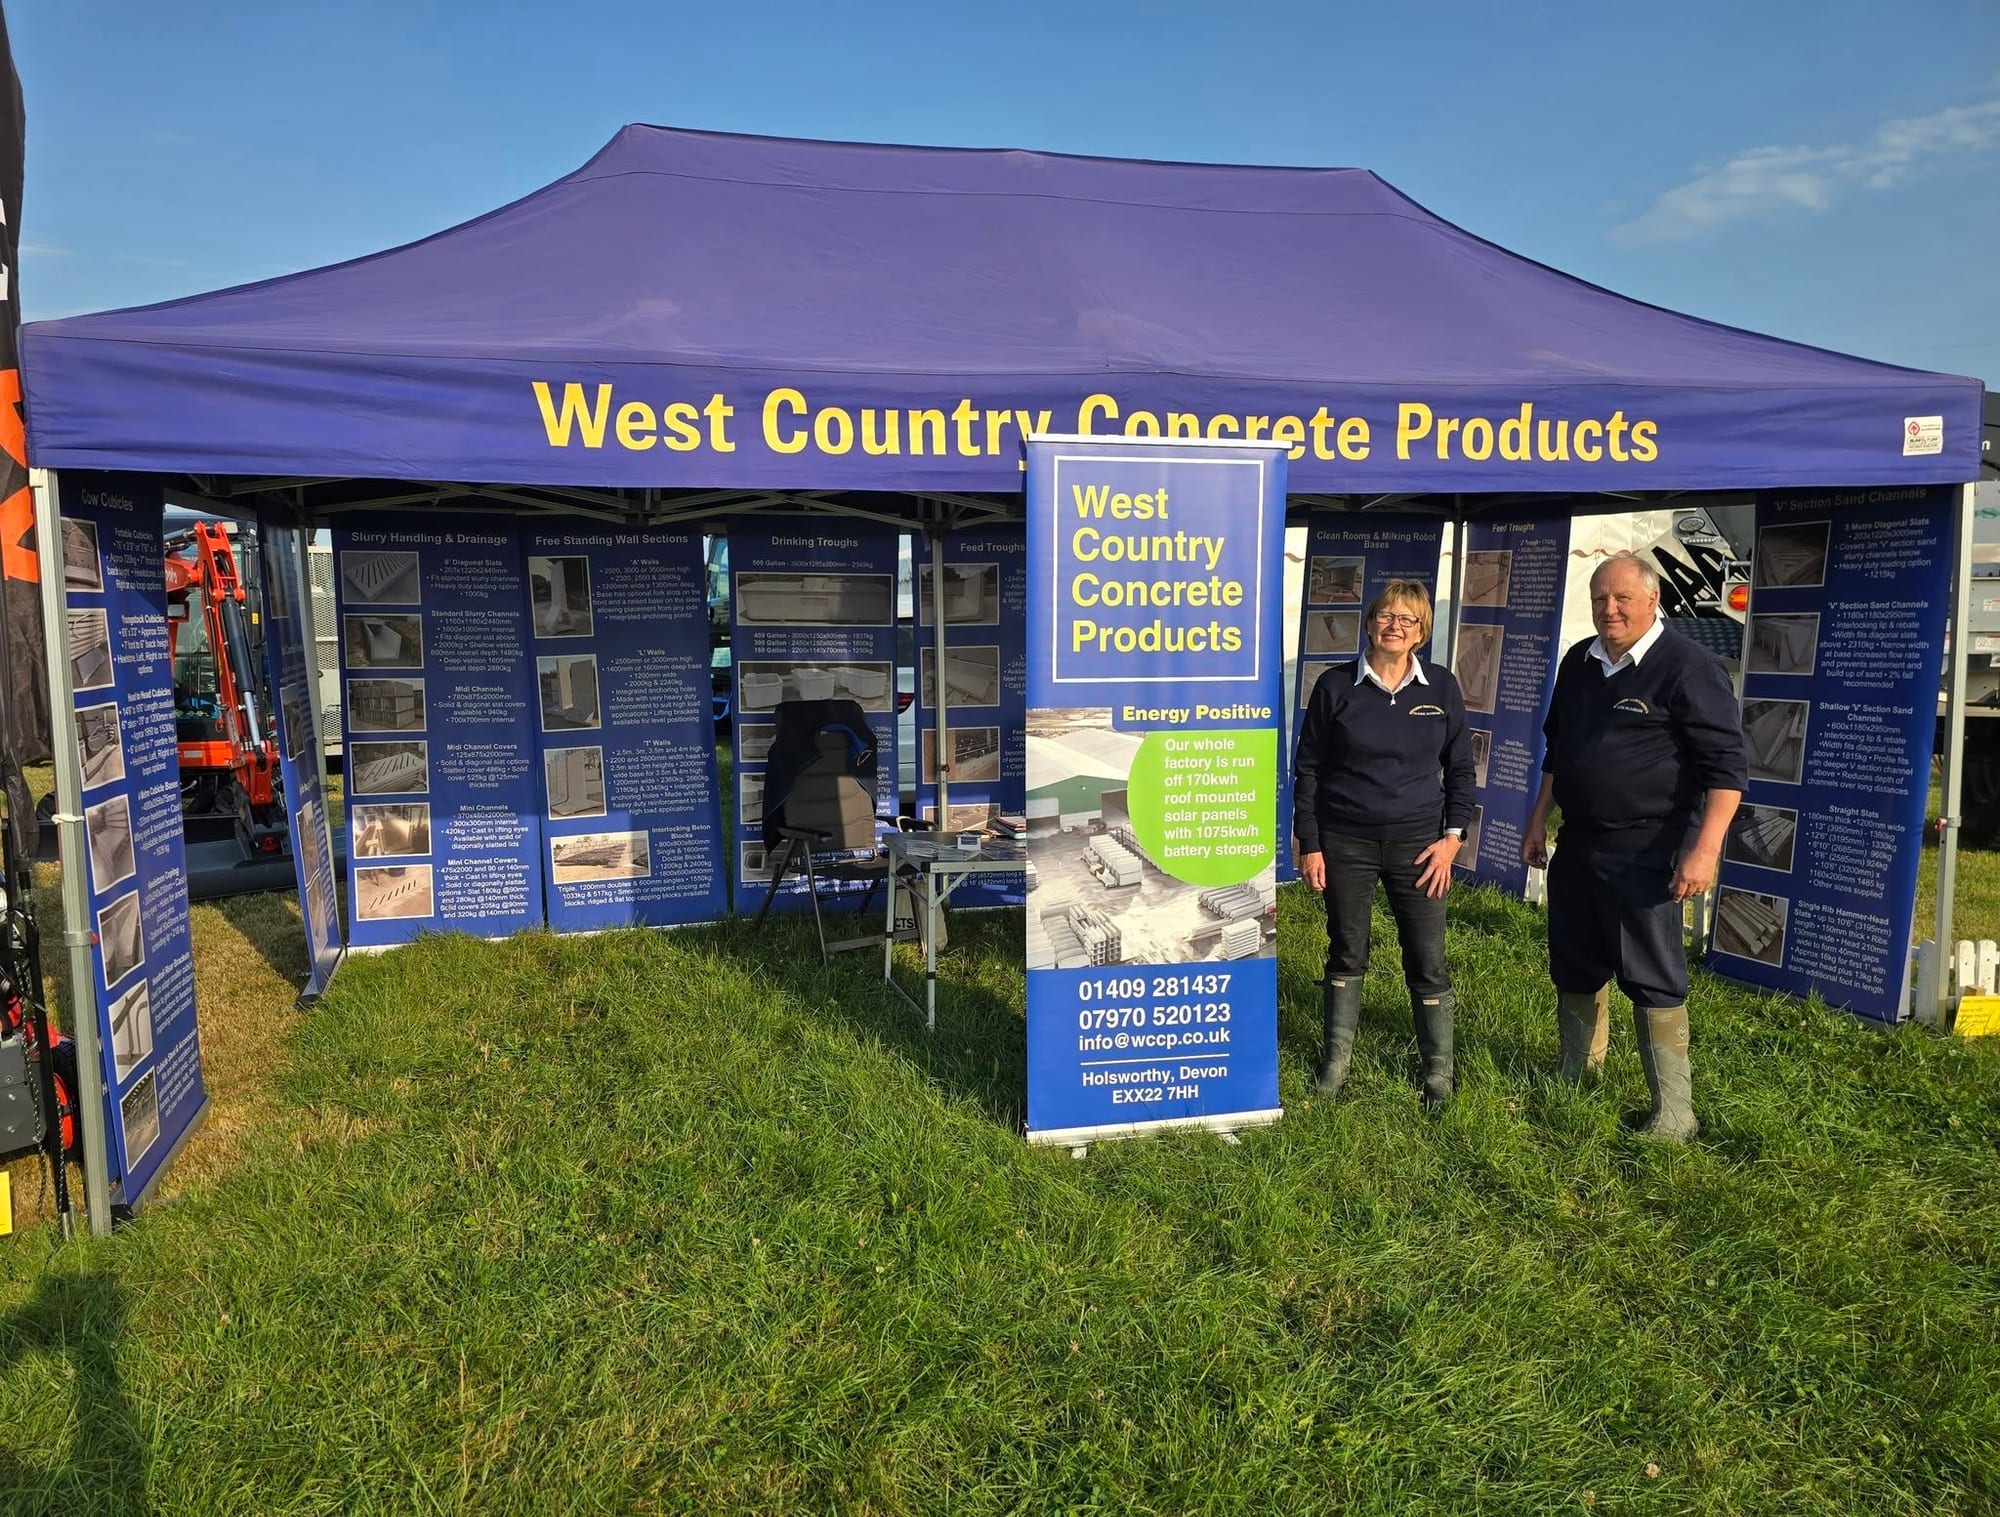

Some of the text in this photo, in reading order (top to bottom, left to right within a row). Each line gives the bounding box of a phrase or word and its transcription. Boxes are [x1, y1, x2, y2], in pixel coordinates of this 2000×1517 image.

[531, 381, 736, 453] West
[1396, 402, 1659, 462] Products
[100, 492, 134, 512] Cubicles
[1072, 484, 1169, 520] West
[1492, 522, 1535, 533] Feed Troughs
[351, 532, 507, 547] Slurry Handling & Drainage
[535, 533, 688, 548] Free Standing Wall Sections
[771, 536, 858, 550] Drinking Troughs
[1316, 530, 1436, 544] Clean Rooms & Milking Robot
[1363, 540, 1390, 549] Bases
[960, 542, 1025, 554] Feed Troughs
[1071, 527, 1225, 570] Country
[1838, 558, 1931, 572] Heavy duty loading option
[1071, 572, 1244, 608] Concrete
[431, 610, 519, 620] Standard Slurry Channels
[1072, 618, 1243, 653] Products
[454, 685, 503, 693] Midi Channels
[1842, 679, 1894, 689] recommended
[1123, 705, 1271, 724] Energy Positive
[1819, 702, 1850, 712] Shallow
[1862, 704, 1891, 714] Section
[1892, 705, 1913, 715] Sand
[1846, 712, 1882, 723] Channels
[446, 743, 517, 751] Midi Channel Covers
[1164, 737, 1235, 751] Our whole
[1165, 756, 1254, 772] factory is run
[1164, 773, 1238, 786] off 170kwh
[1806, 777, 1908, 796] channels over long distances
[1164, 790, 1255, 805] roof mounted
[459, 803, 508, 812] Mini Channels
[1828, 805, 1879, 819] Straight Slats
[1164, 808, 1247, 824] solar panels
[670, 832, 693, 841] Blocks
[1164, 825, 1258, 840] with 1075kw/h
[1164, 842, 1268, 861] battery storage.
[447, 856, 517, 867] Mini Channel Covers
[1812, 878, 1883, 901] Other sizes supplied
[1797, 900, 1889, 926] Single Rib Hammer-Head
[1078, 973, 1231, 1000] 01409 281437
[1787, 963, 1884, 997] each additional foot in length
[1079, 1002, 1230, 1030] 07970 520123
[1078, 1028, 1231, 1053] info@wccp.co.uk
[1083, 1064, 1227, 1091] Holsworthy, Devon
[1112, 1085, 1198, 1105] EXX22 7HH
